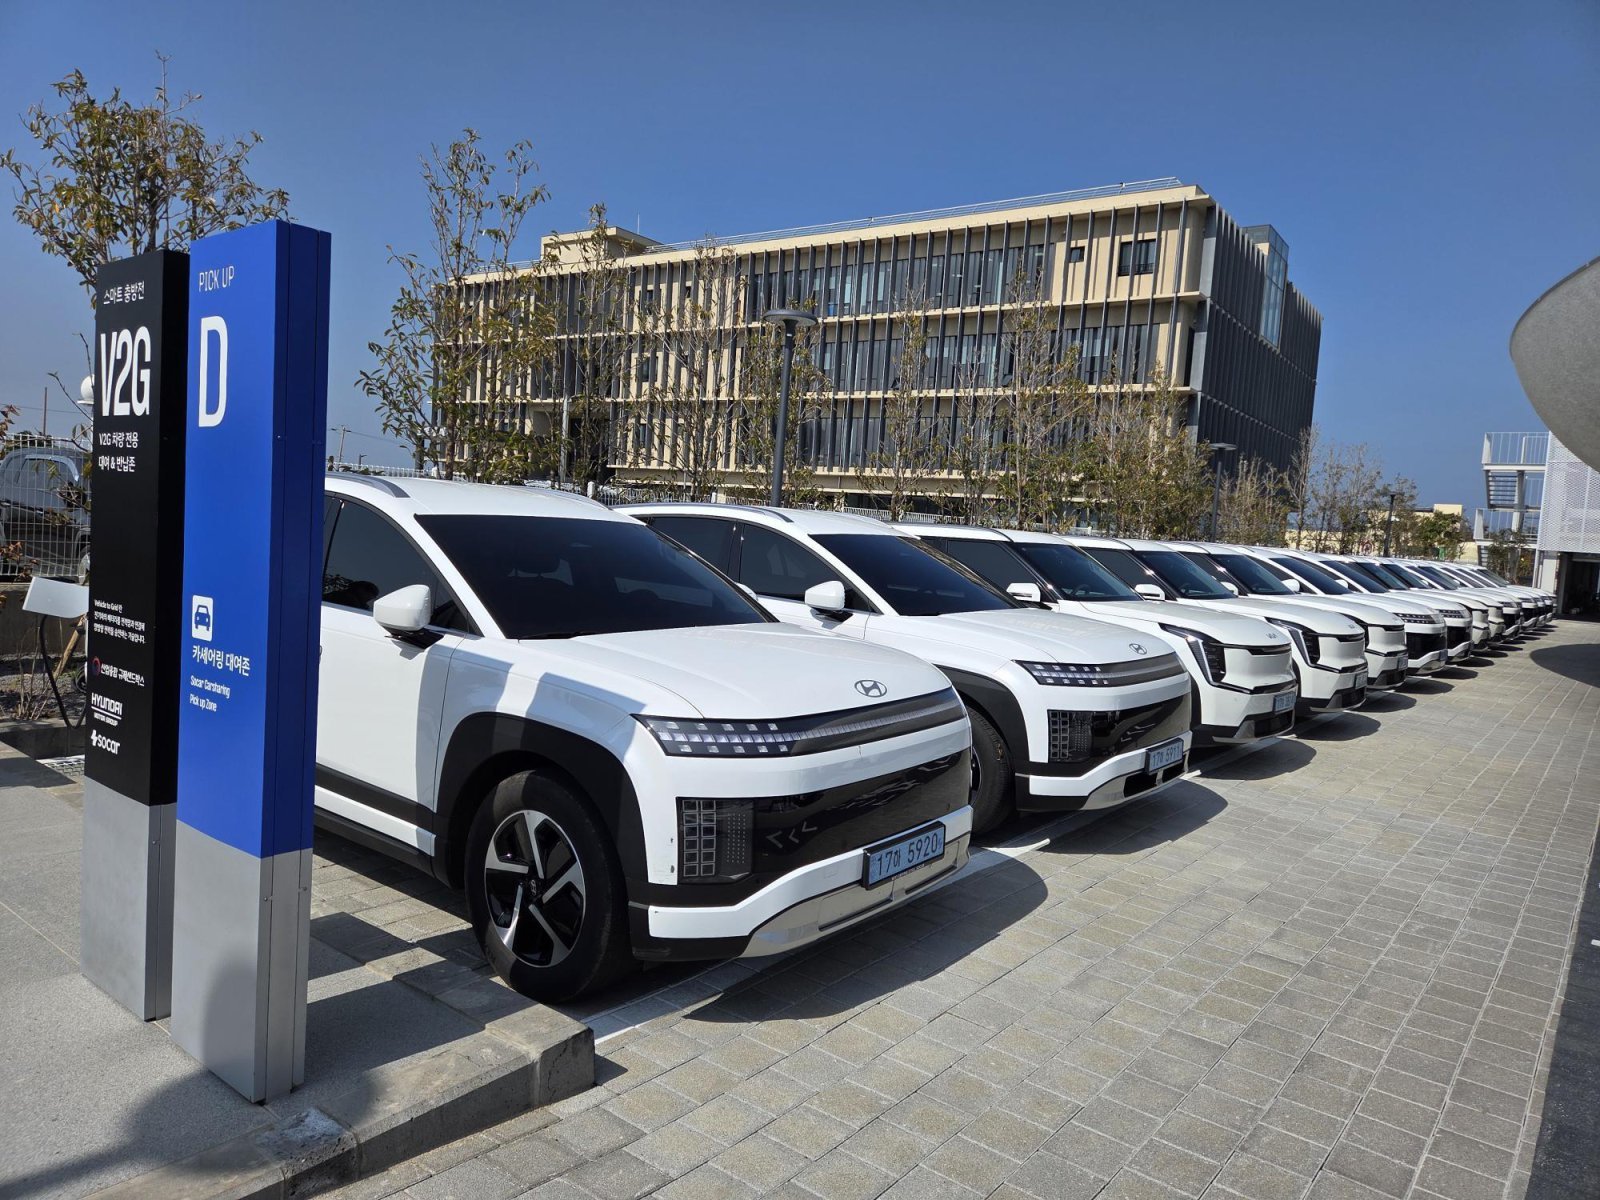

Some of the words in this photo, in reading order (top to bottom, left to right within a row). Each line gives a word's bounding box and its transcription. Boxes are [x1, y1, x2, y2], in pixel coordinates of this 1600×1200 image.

[199, 270, 220, 292] PICK
[222, 265, 235, 288] UP
[103, 287, 123, 304] 스마트
[124, 280, 145, 303] 충방전
[100, 326, 151, 417] V2G
[198, 315, 228, 428] D
[99, 432, 112, 446] V2G
[112, 431, 125, 448] 차량
[125, 431, 139, 449] 전용
[98, 455, 110, 470] 대여
[110, 456, 116, 470] &
[116, 455, 136, 472] 반납존
[225, 653, 251, 677] 대여존
[190, 675, 204, 689] Socar
[204, 679, 230, 699] Carsharing
[91, 692, 123, 716] HYUNDAI
[205, 698, 217, 712] Zone
[907, 832, 938, 864] 5920
